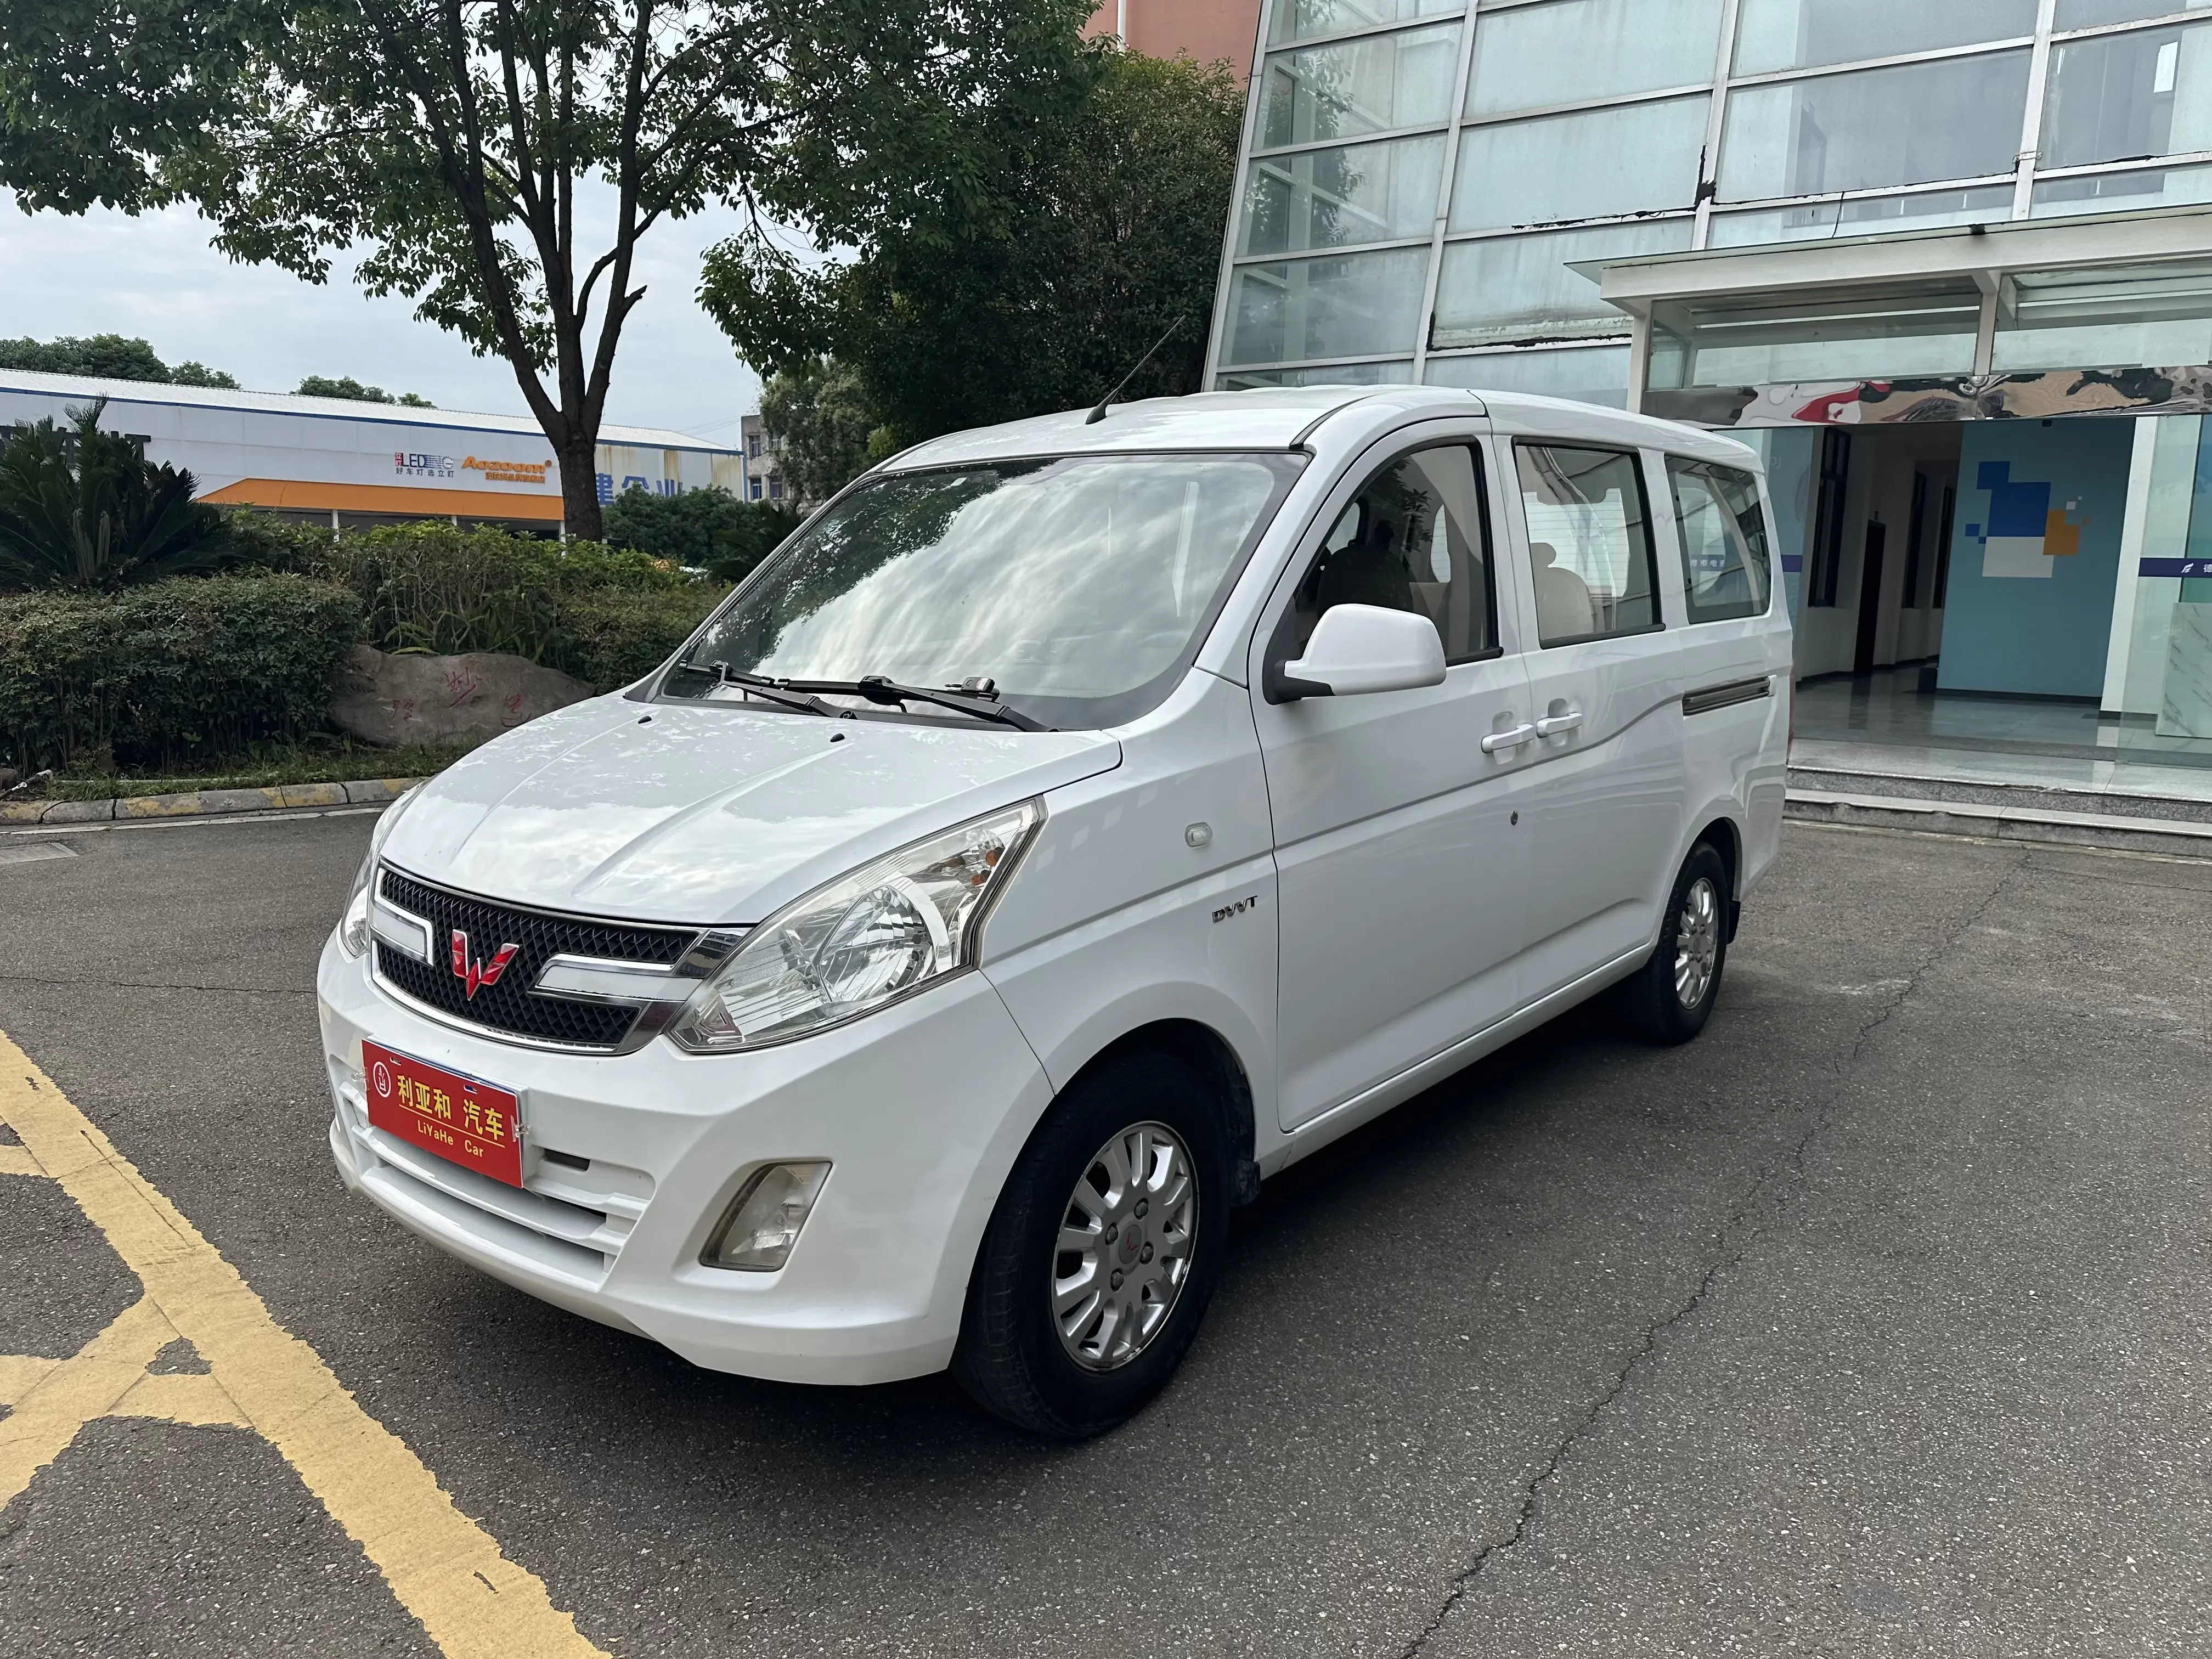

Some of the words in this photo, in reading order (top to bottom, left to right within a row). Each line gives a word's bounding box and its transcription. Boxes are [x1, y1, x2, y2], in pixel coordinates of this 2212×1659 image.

[461, 456, 546, 474] Aozoom
[1212, 895, 1257, 923] DVVT
[397, 1075, 452, 1120] 利亚和
[462, 1098, 504, 1141] 汽车
[417, 1120, 454, 1146] LiYaHe
[465, 1139, 484, 1158] Car
